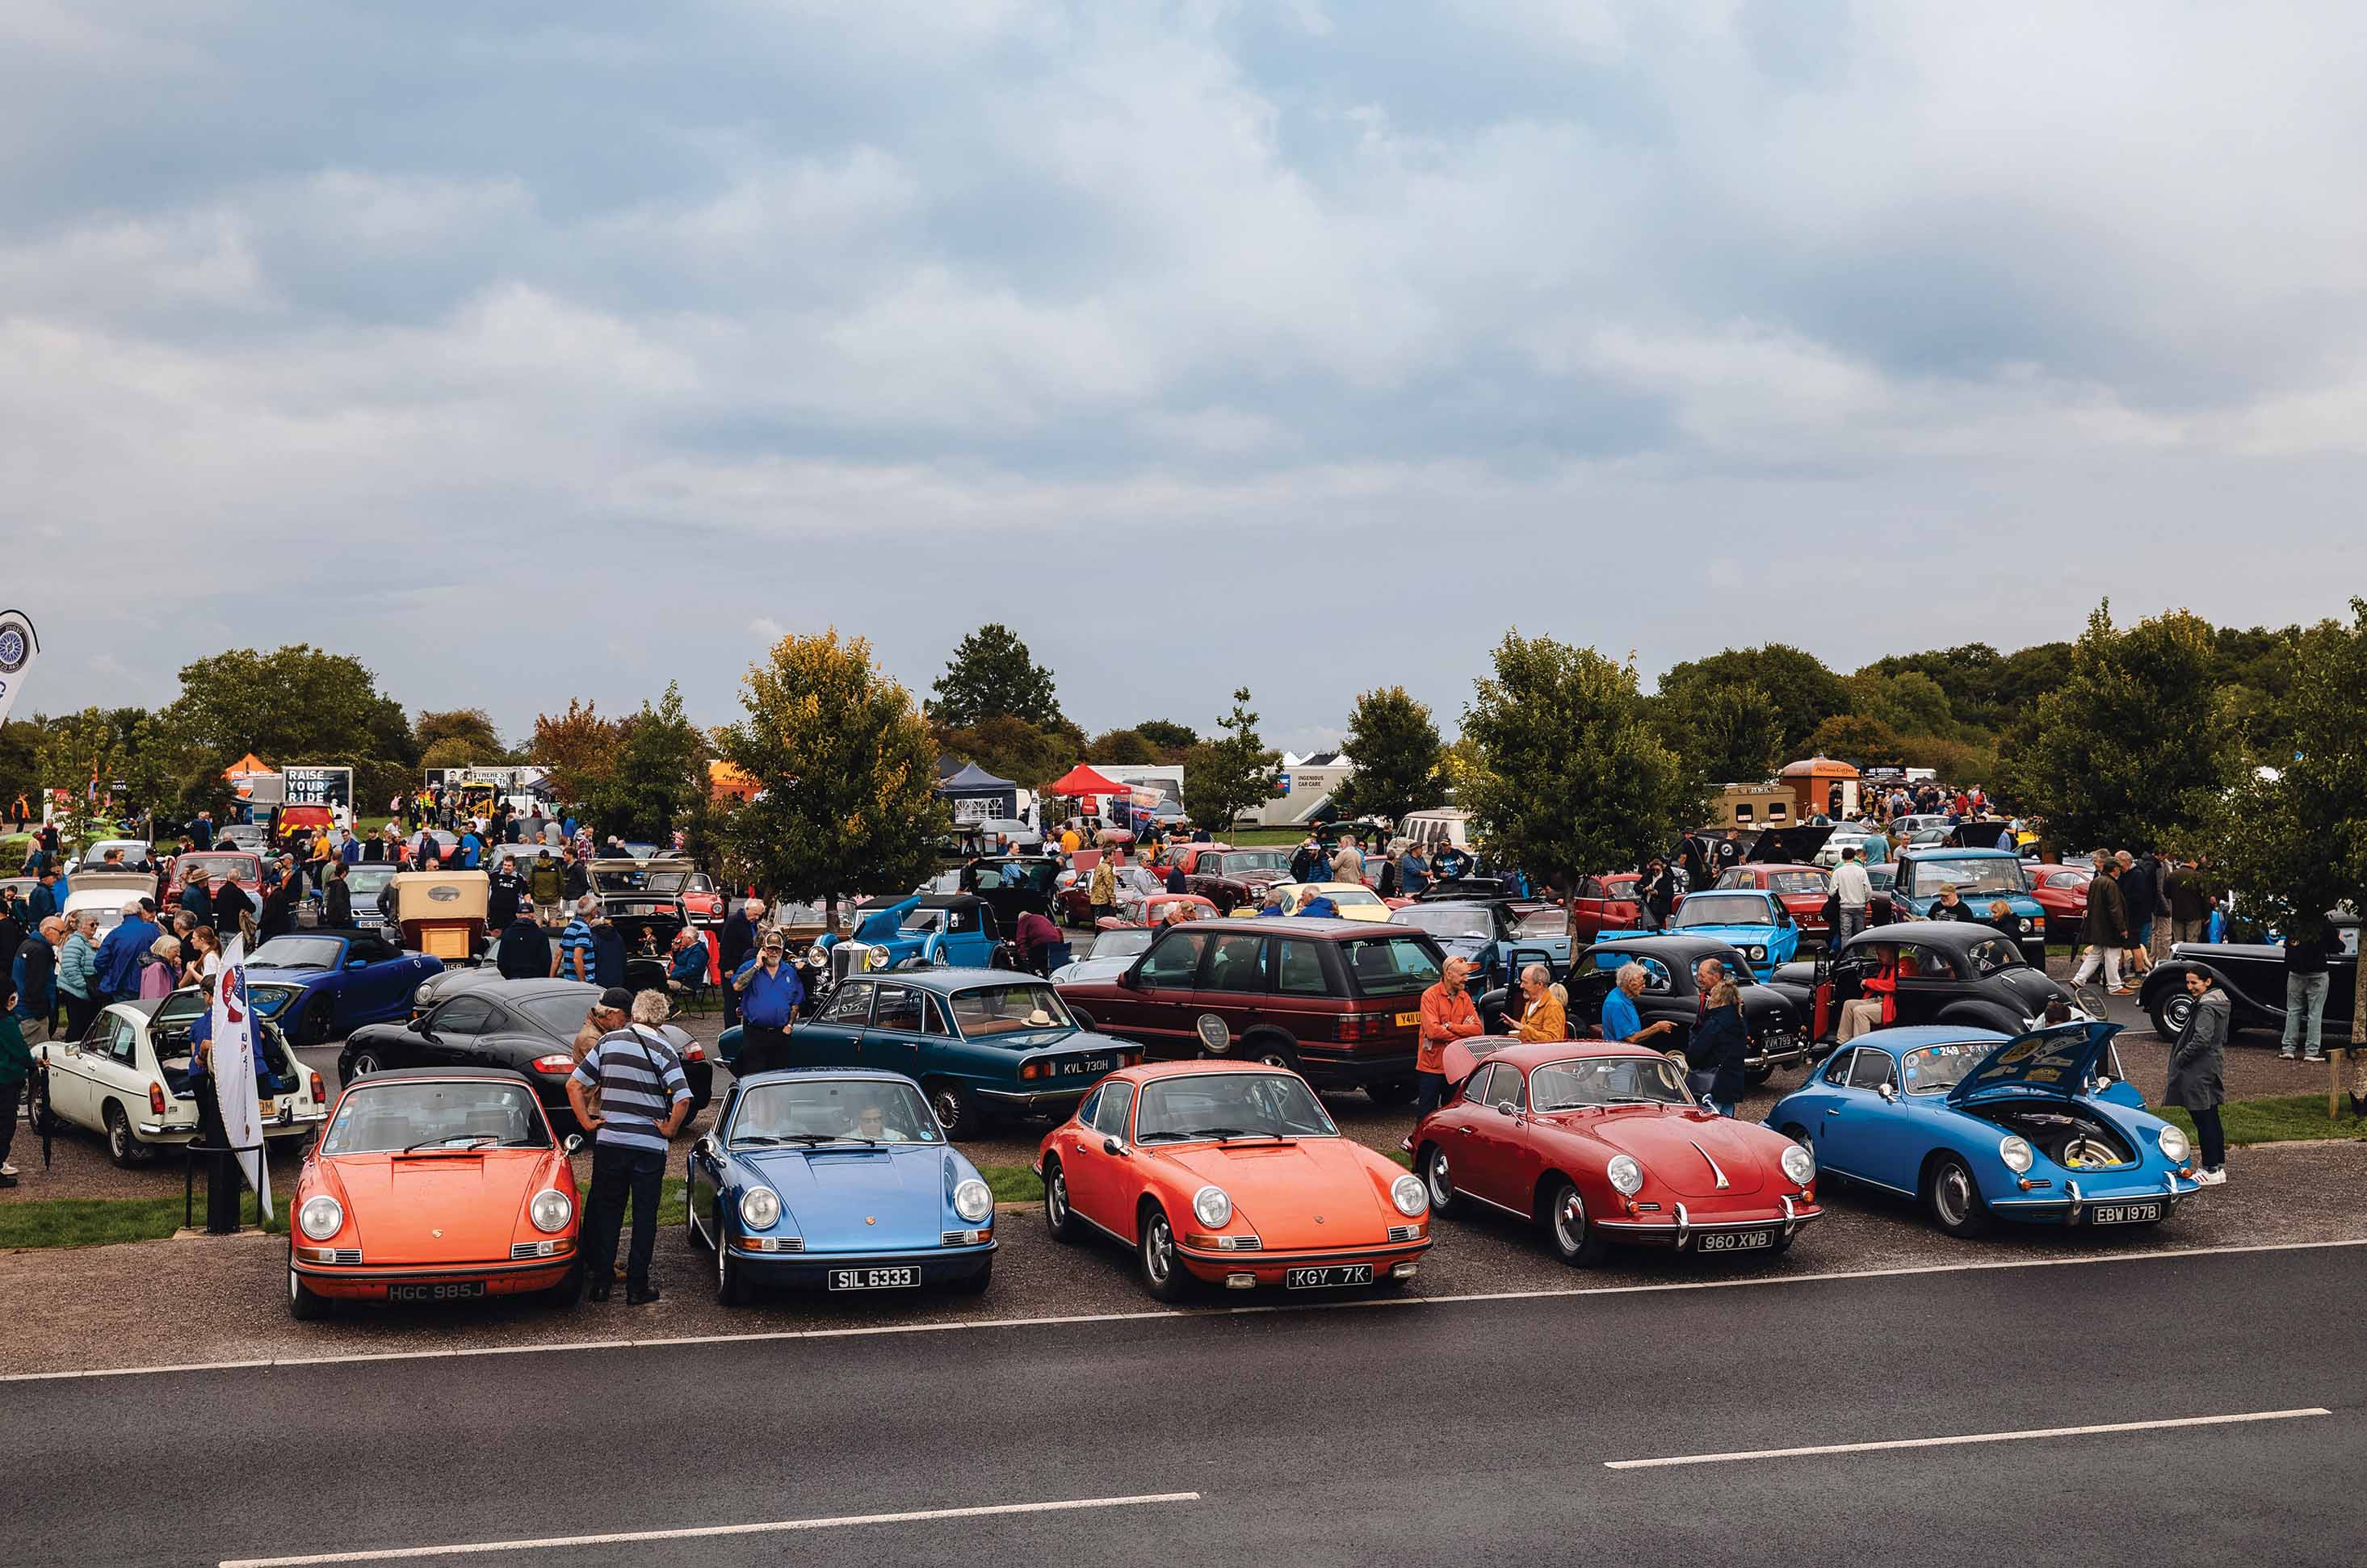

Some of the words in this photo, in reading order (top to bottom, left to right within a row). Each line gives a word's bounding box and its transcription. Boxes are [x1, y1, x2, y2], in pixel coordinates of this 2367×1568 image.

[289, 771, 325, 780] RAISE
[287, 781, 325, 791] YOUR
[288, 792, 324, 802] RIDE
[1764, 1038, 1778, 1048] XVM
[1777, 1036, 1790, 1047] 799
[1939, 1046, 1960, 1056] 249
[1064, 1063, 1084, 1075] KVL
[1085, 1059, 1109, 1071] 730H
[2097, 1207, 2124, 1222] EBW
[2127, 1205, 2156, 1220] 197B
[1705, 1235, 1735, 1249] 960
[1738, 1233, 1767, 1247] XWB
[838, 1272, 865, 1288] SIL
[868, 1268, 912, 1286] 6333
[1295, 1269, 1328, 1285] KGY
[1342, 1267, 1366, 1283] 7K
[388, 1285, 427, 1301] HGC
[434, 1282, 485, 1299] 985J
